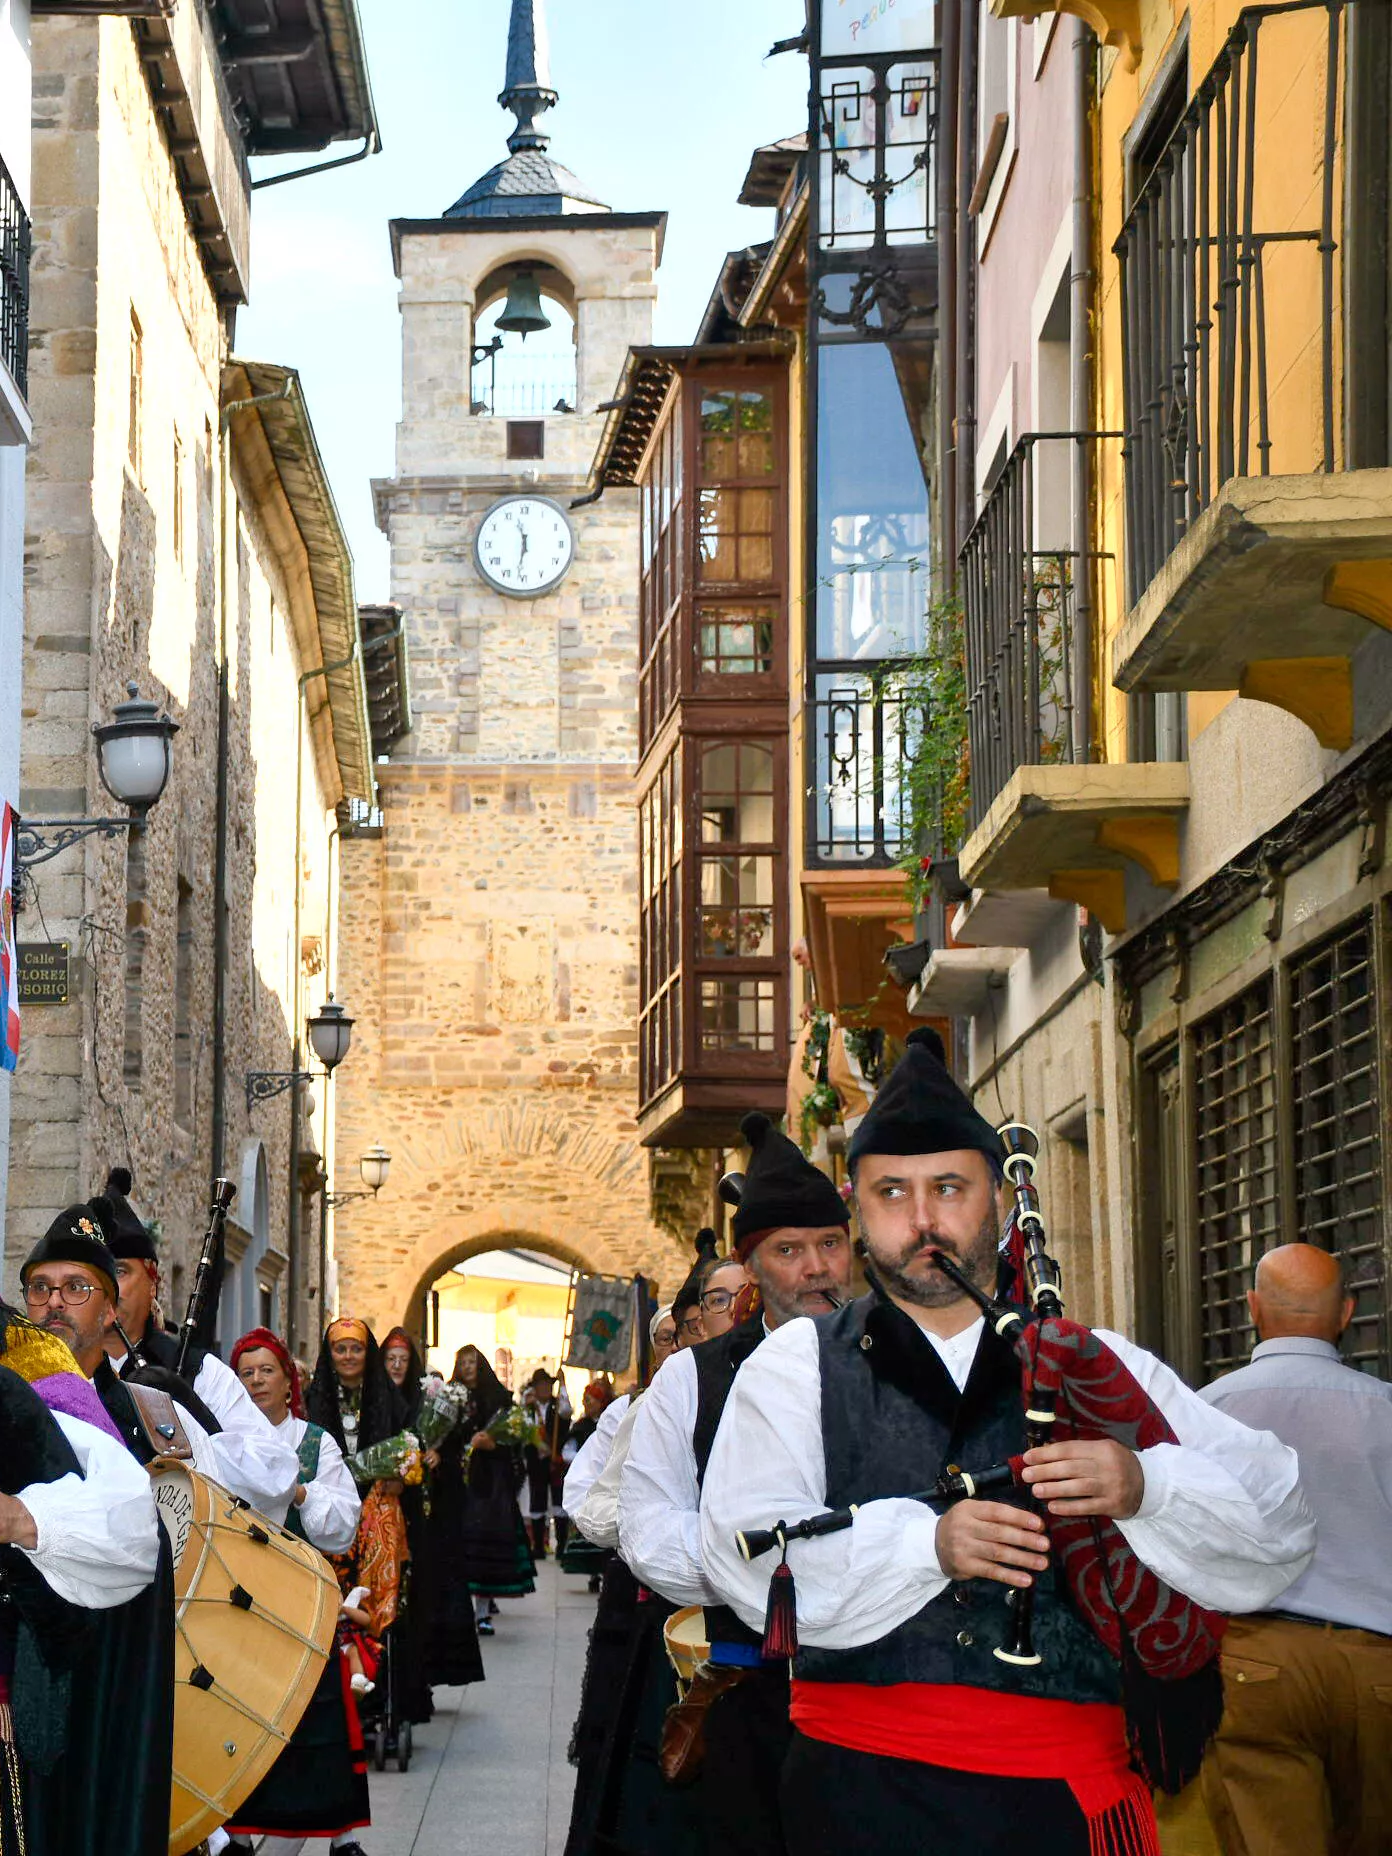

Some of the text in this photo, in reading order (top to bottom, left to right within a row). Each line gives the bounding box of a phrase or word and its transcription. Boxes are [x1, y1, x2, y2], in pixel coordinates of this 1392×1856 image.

[24, 953, 55, 964] Calle
[152, 1485, 181, 1508] NDA
[174, 1493, 192, 1525] DE
